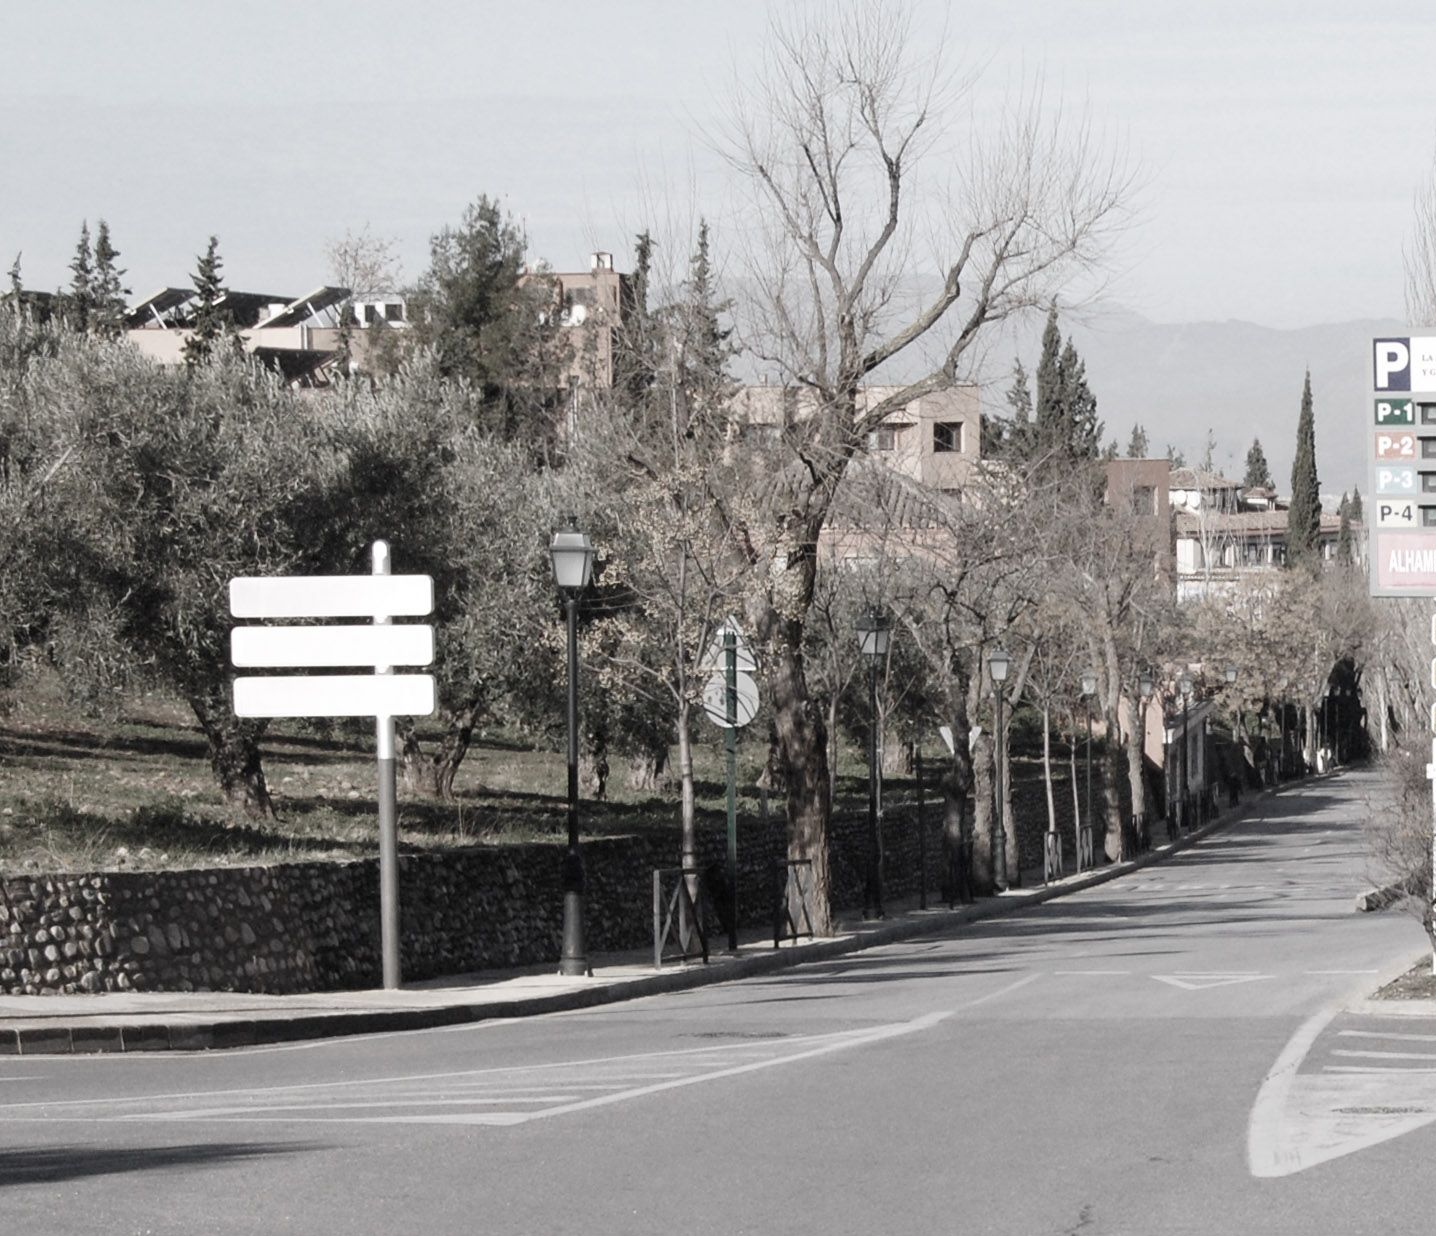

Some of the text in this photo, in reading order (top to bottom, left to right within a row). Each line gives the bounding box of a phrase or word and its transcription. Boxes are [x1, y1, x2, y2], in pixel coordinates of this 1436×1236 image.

[1375, 341, 1409, 388] P
[1422, 353, 1433, 361] LA
[1377, 402, 1413, 422] P-1
[1378, 436, 1414, 456] P-2
[1379, 470, 1413, 489] P-3
[1380, 505, 1413, 521] P-4
